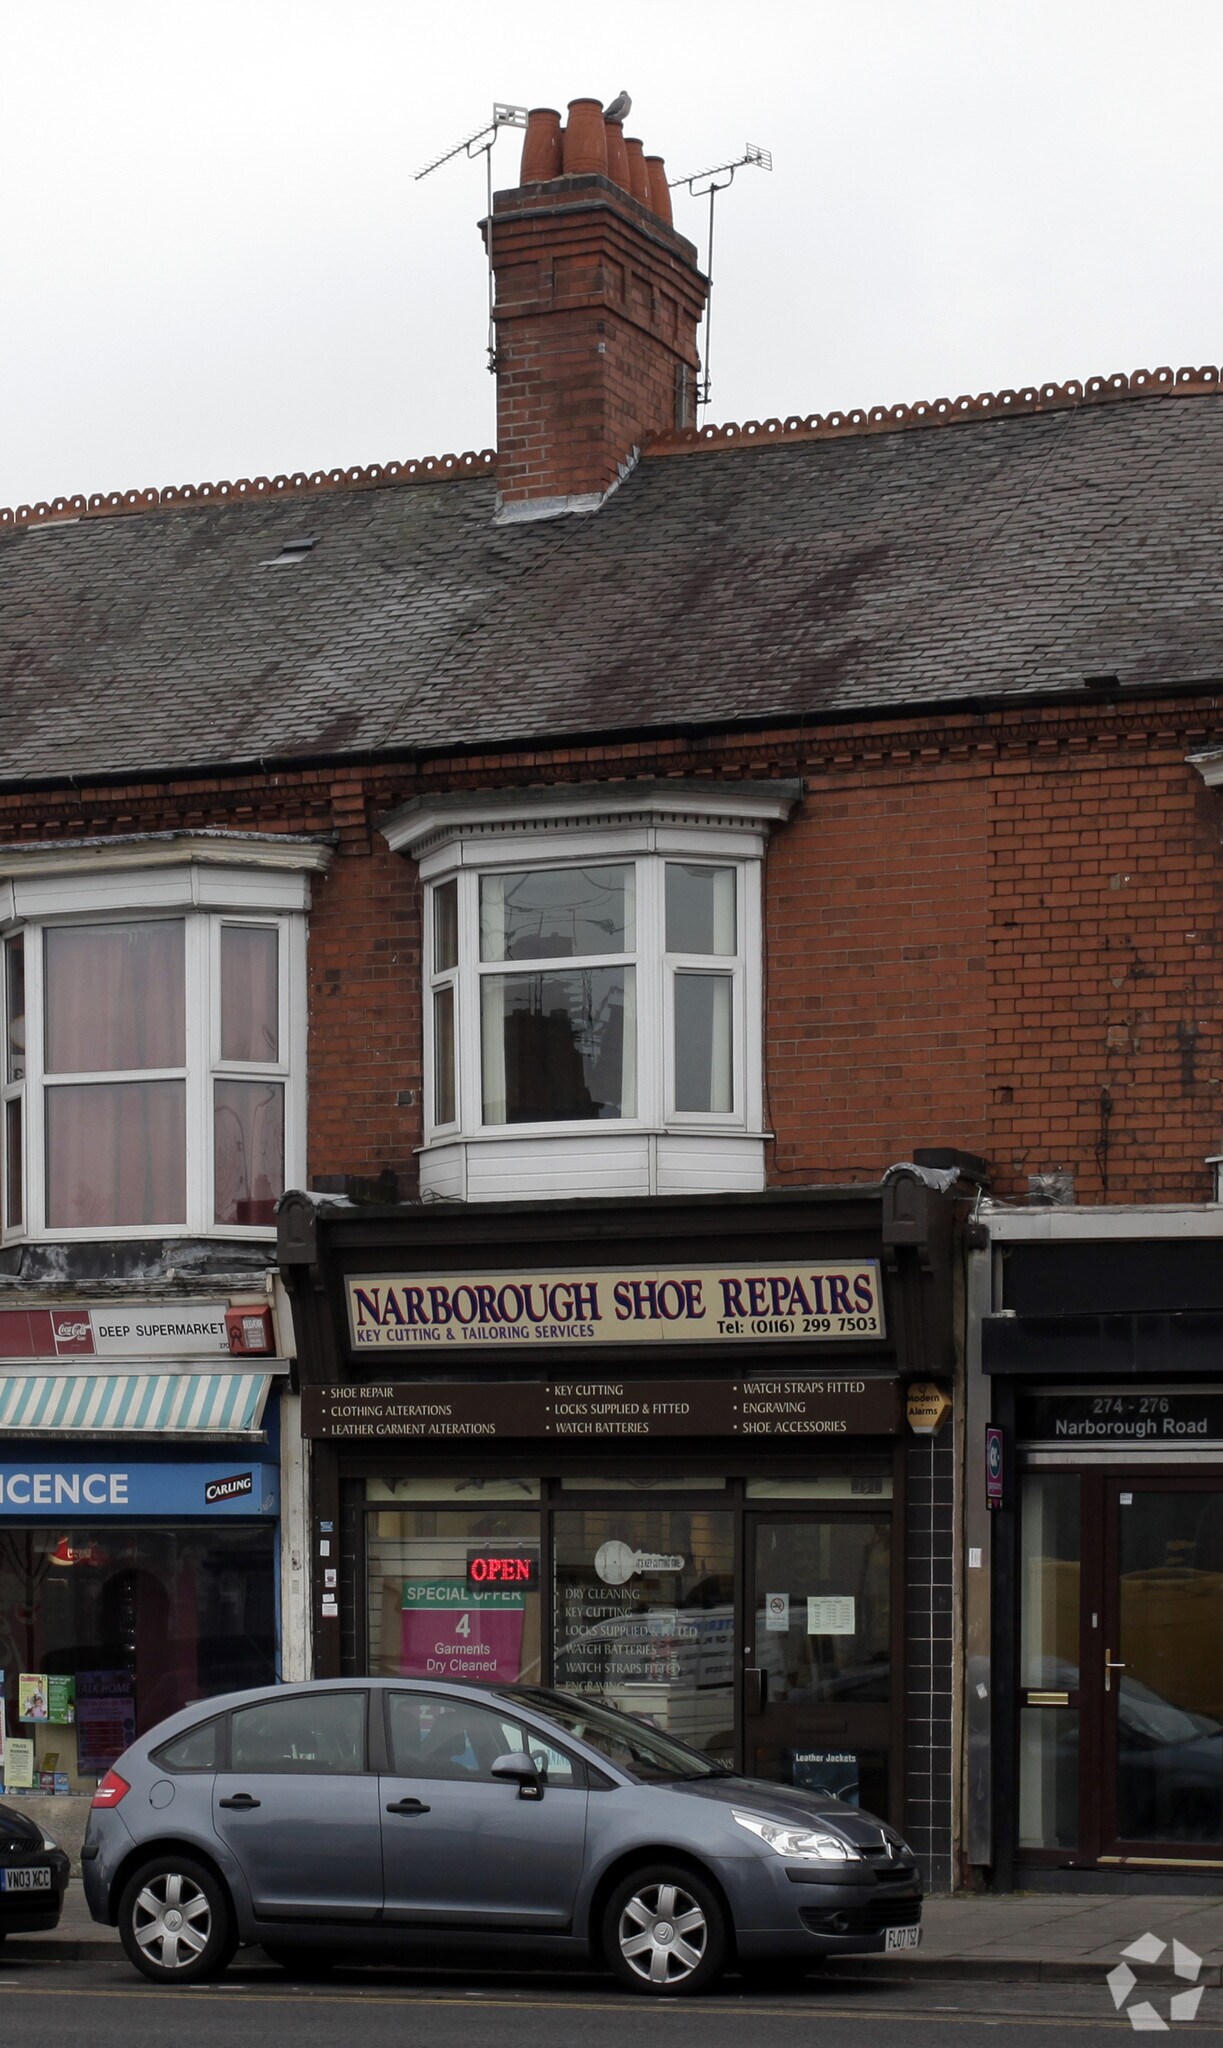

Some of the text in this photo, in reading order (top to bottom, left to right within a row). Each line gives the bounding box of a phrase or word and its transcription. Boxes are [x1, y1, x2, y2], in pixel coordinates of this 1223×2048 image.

[353, 1273, 874, 1326] NARBOROUGH SHOE REPAIRS
[99, 1322, 225, 1338] DEEP SUPERMARKET
[717, 1317, 877, 1335] Tel: (0116) 299 7503
[357, 1324, 595, 1342] KEY CUTTING & TAILORING SERVICES
[330, 1387, 394, 1399] SHOE REPAIR
[555, 1385, 624, 1396] KEY CUTTING
[743, 1381, 865, 1394] WATCH STRAPS FITTED
[908, 1394, 940, 1402] Modern
[331, 1404, 452, 1417] CLOTHING ALTERATIONS
[555, 1402, 690, 1415] LOCKS SUPPLIED & FITTED
[743, 1402, 806, 1413] ENGRAVING
[909, 1407, 938, 1415] Alarms
[1093, 1399, 1123, 1414] 274
[1139, 1398, 1170, 1413] 276
[331, 1422, 496, 1435] LEATHER GARMENT ALTERATIONS
[556, 1421, 649, 1433] WATCH BATTERIES
[742, 1421, 847, 1433] SHOE ACCESSORIES
[1055, 1418, 1208, 1438] Narborough Road
[206, 1478, 251, 1500] CARLING
[471, 1558, 531, 1581] OPEN
[407, 1587, 522, 1601] SPECIAL OFFER
[565, 1588, 640, 1600] DRY CLEANING
[565, 1607, 633, 1618] KEY CUTTING
[455, 1613, 471, 1638] 4
[565, 1626, 598, 1637] LOCKS
[600, 1626, 648, 1637] SUPPLIED
[434, 1643, 490, 1655] Garments
[566, 1644, 657, 1655] WATCH BATTERIES
[426, 1659, 497, 1674] Dry Cleaned
[566, 1663, 602, 1673] WATCH
[604, 1662, 641, 1673] STRAPS
[102, 1683, 131, 1693] HOME
[795, 1752, 857, 1762] Leather Jackets
[7, 1869, 50, 1888] VN03 XCC
